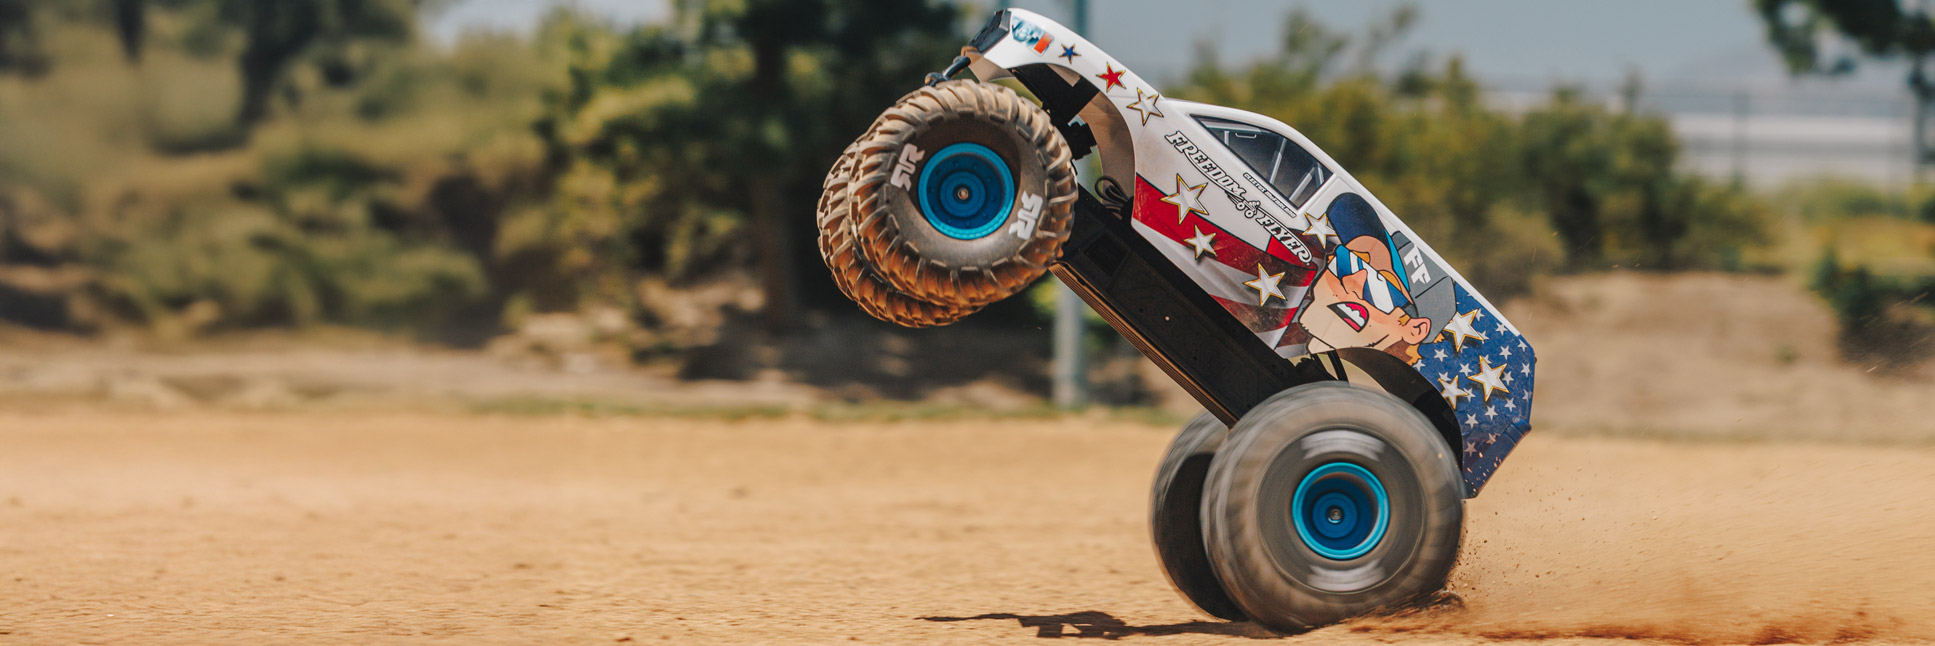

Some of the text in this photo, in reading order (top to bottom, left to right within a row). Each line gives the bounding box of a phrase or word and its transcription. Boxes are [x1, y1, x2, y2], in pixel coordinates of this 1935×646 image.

[1164, 130, 1313, 263] FREEDOM FLYER
[1403, 244, 1431, 284] FF
